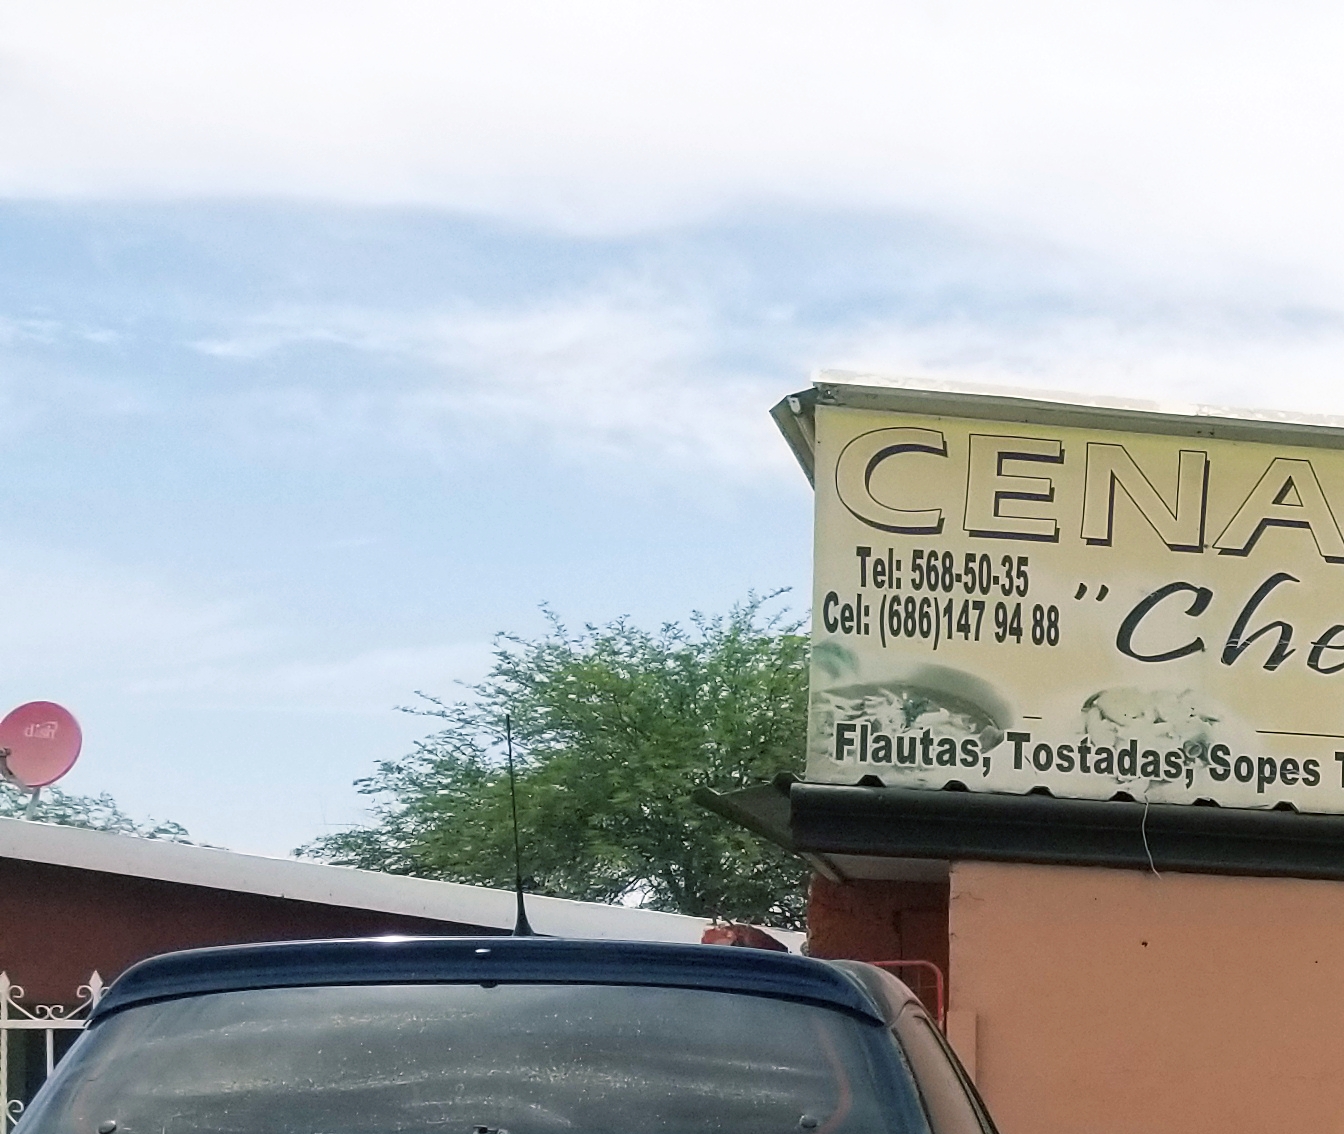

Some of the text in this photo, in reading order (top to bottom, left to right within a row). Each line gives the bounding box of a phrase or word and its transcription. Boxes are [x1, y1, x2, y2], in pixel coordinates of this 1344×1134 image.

[855, 545, 1030, 598] Tel: 568-50-35
[822, 590, 871, 636] Cel:
[994, 600, 1023, 645] 94
[1031, 603, 1061, 647] 88
[834, 722, 993, 779] Flautas,
[1006, 731, 1195, 790] Tostadas,
[1209, 744, 1322, 794] Sopes
